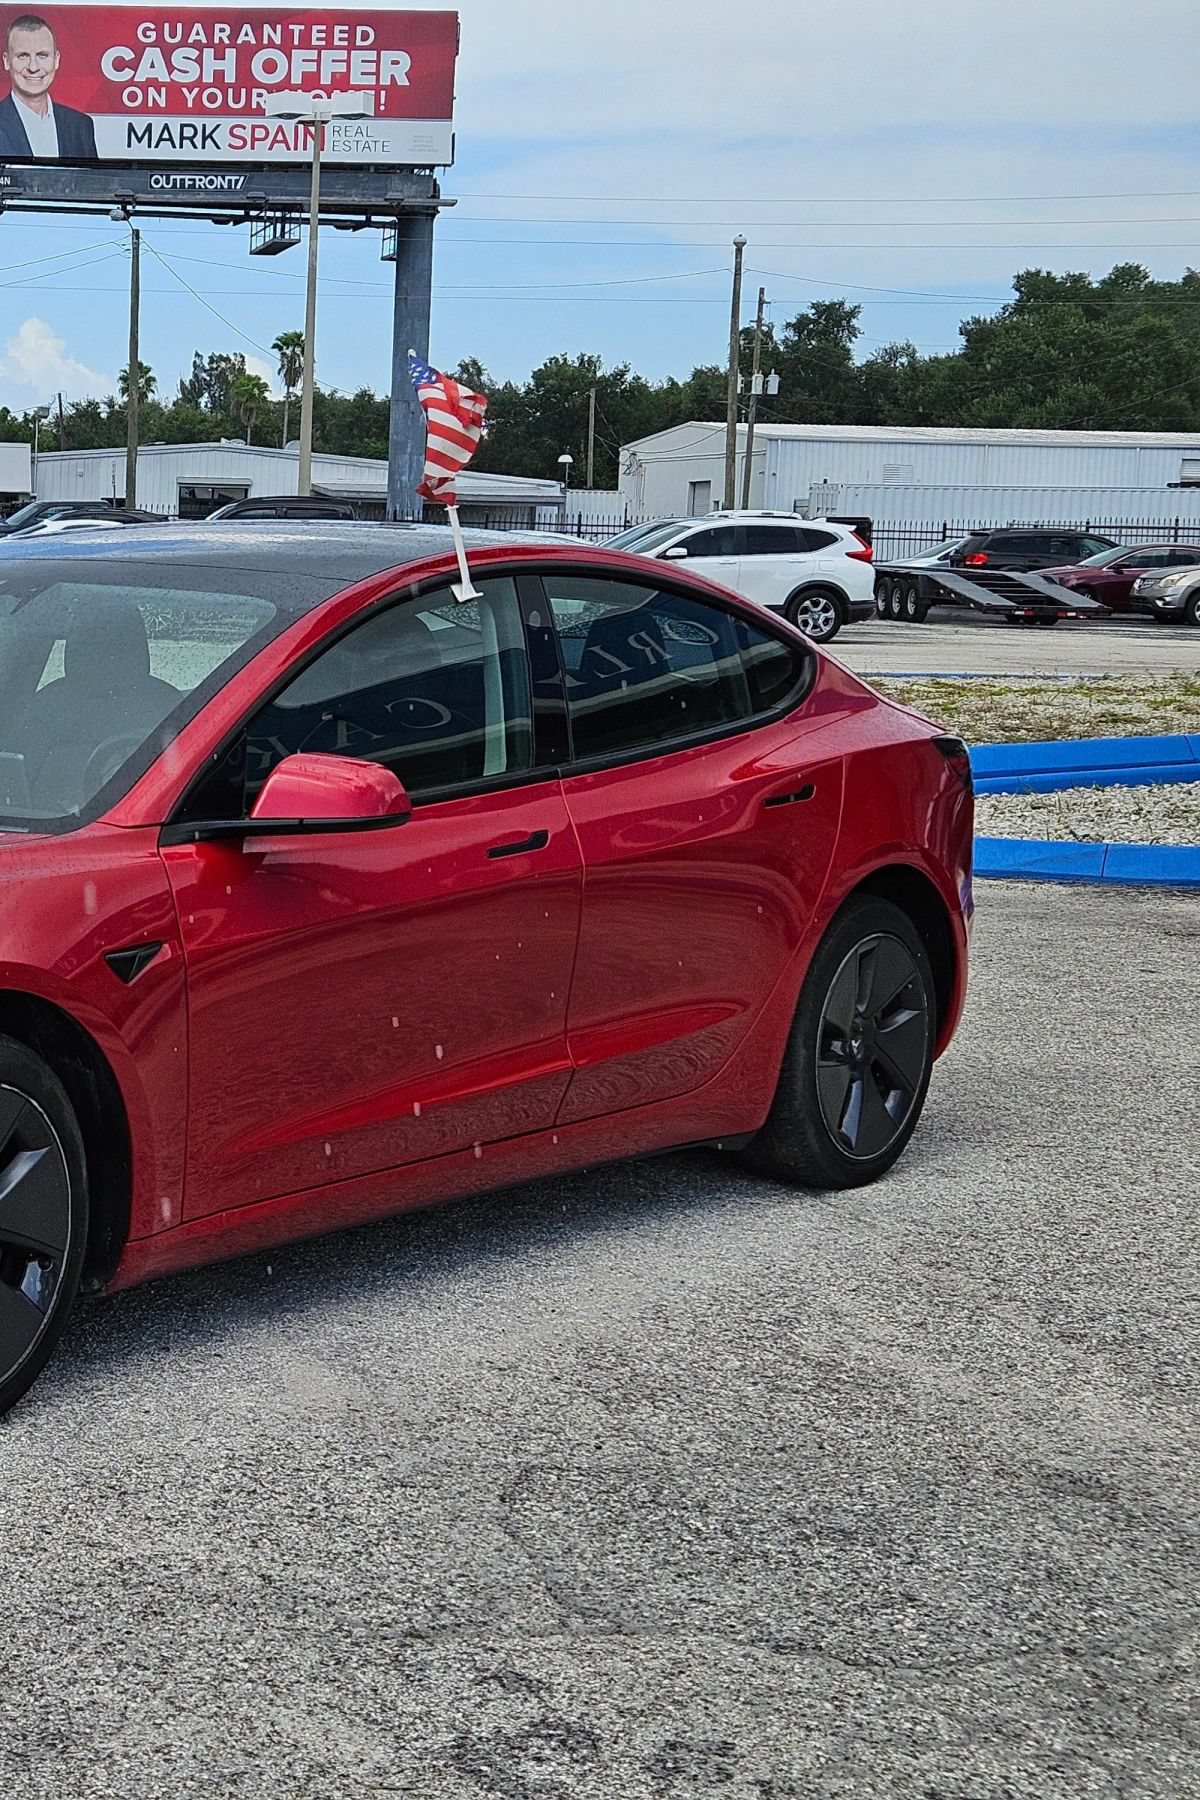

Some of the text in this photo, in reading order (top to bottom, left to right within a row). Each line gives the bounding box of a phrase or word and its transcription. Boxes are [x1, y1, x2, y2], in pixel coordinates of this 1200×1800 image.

[137, 22, 375, 46] GUARANTEED
[101, 46, 412, 86] CASH OFFER
[122, 86, 167, 108] ON
[181, 87, 268, 109] YOUR
[127, 122, 375, 151] MARK SPAIN REAL
[332, 139, 392, 153] ESTATE
